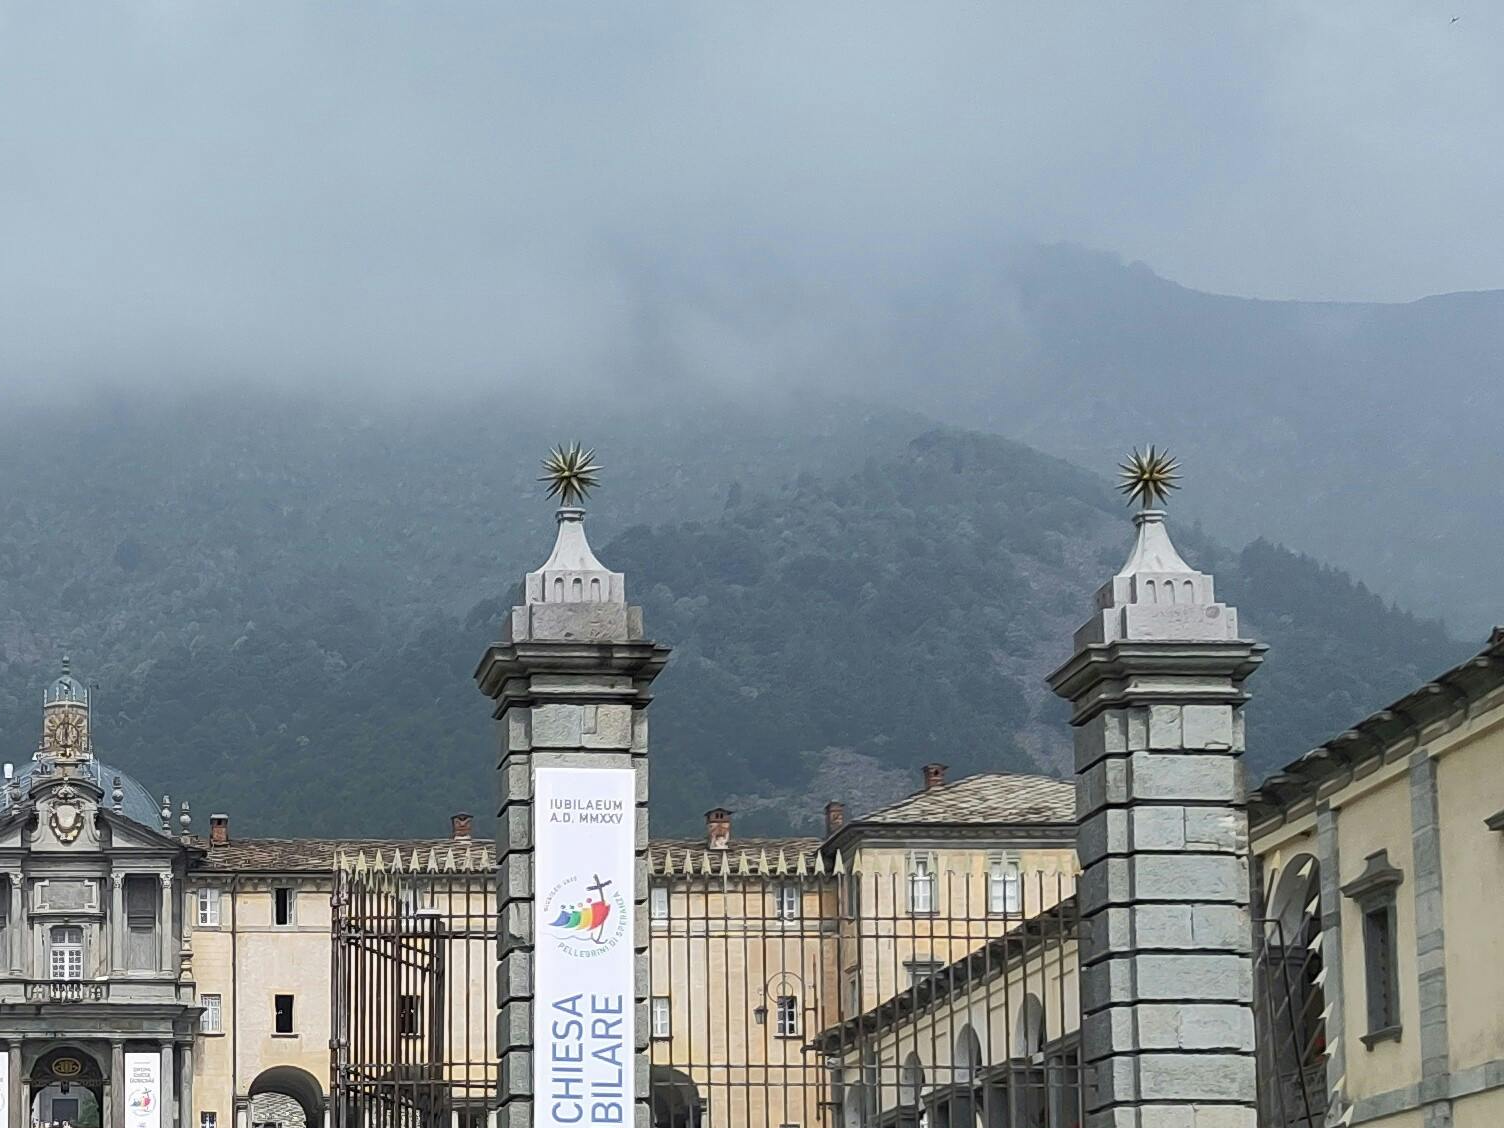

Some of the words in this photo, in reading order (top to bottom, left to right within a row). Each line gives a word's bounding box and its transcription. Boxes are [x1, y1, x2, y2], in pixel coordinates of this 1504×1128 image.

[550, 799, 623, 811] IUBILAEUM
[550, 812, 575, 824] A.D.
[579, 813, 624, 825] MMXXV
[551, 993, 583, 1123] CHIESA
